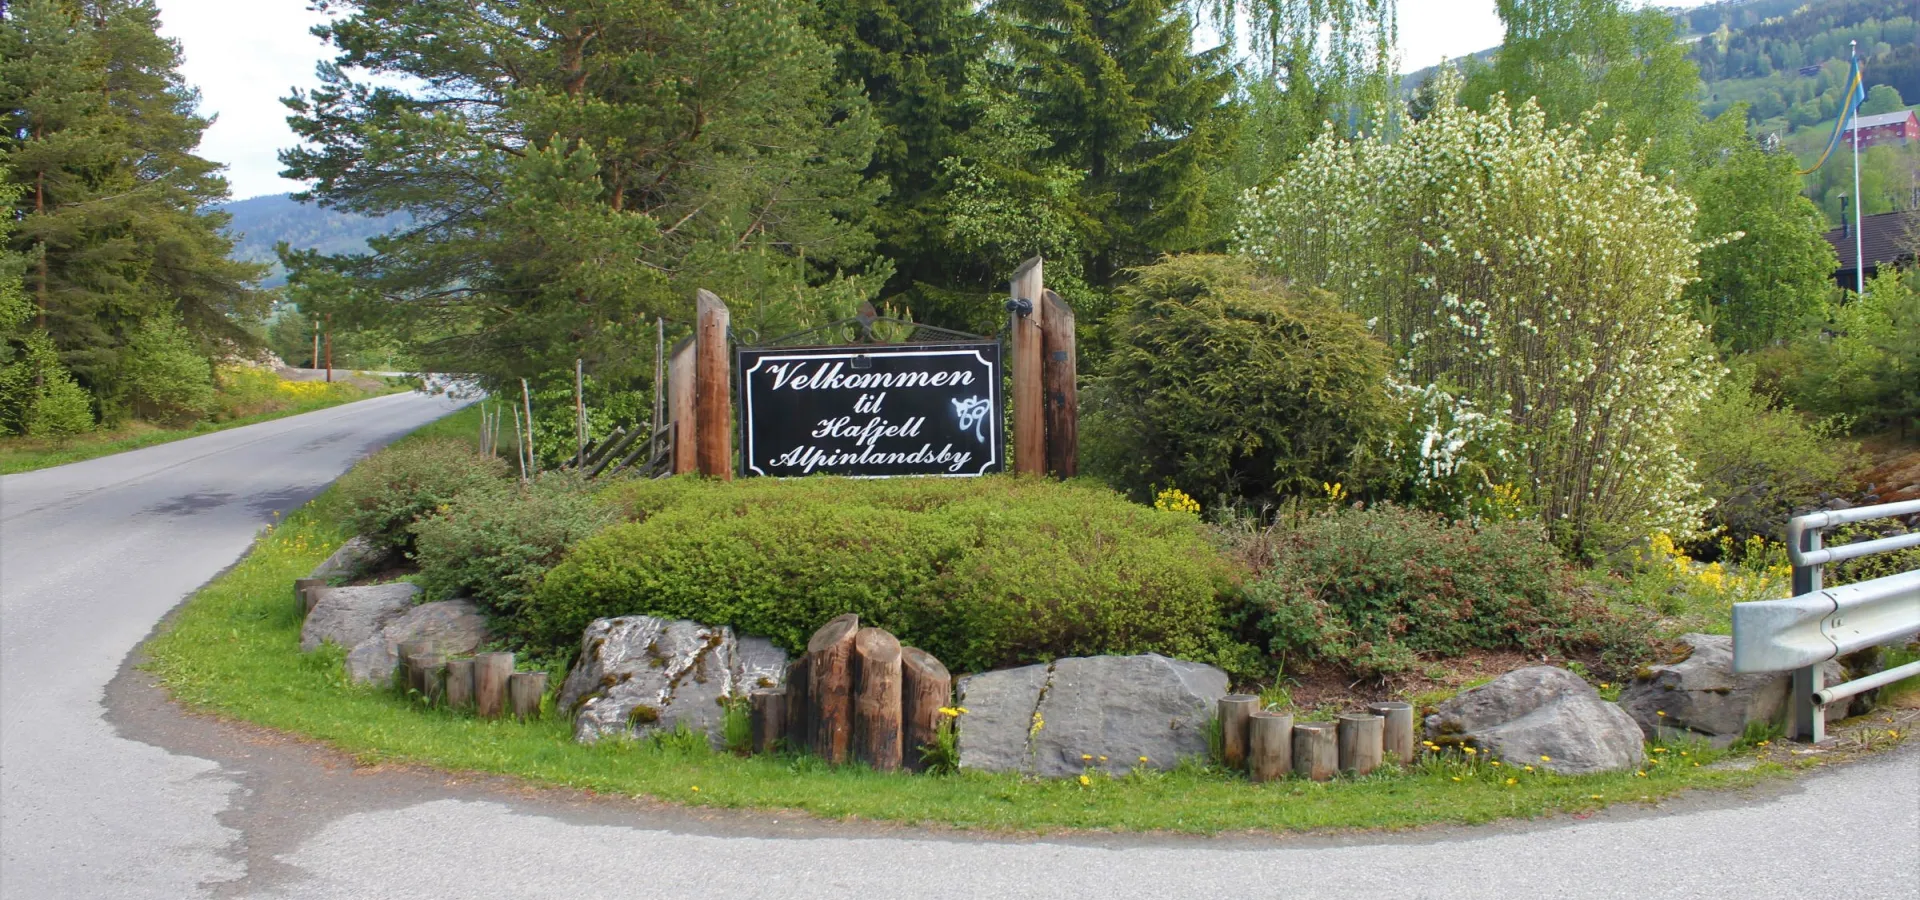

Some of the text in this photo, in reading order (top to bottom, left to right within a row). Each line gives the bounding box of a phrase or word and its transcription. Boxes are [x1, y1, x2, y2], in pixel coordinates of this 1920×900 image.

[765, 361, 976, 391] Velkommen
[853, 391, 887, 414] til
[811, 416, 926, 446] Hafjell
[769, 443, 973, 474] Alpinlandsby
